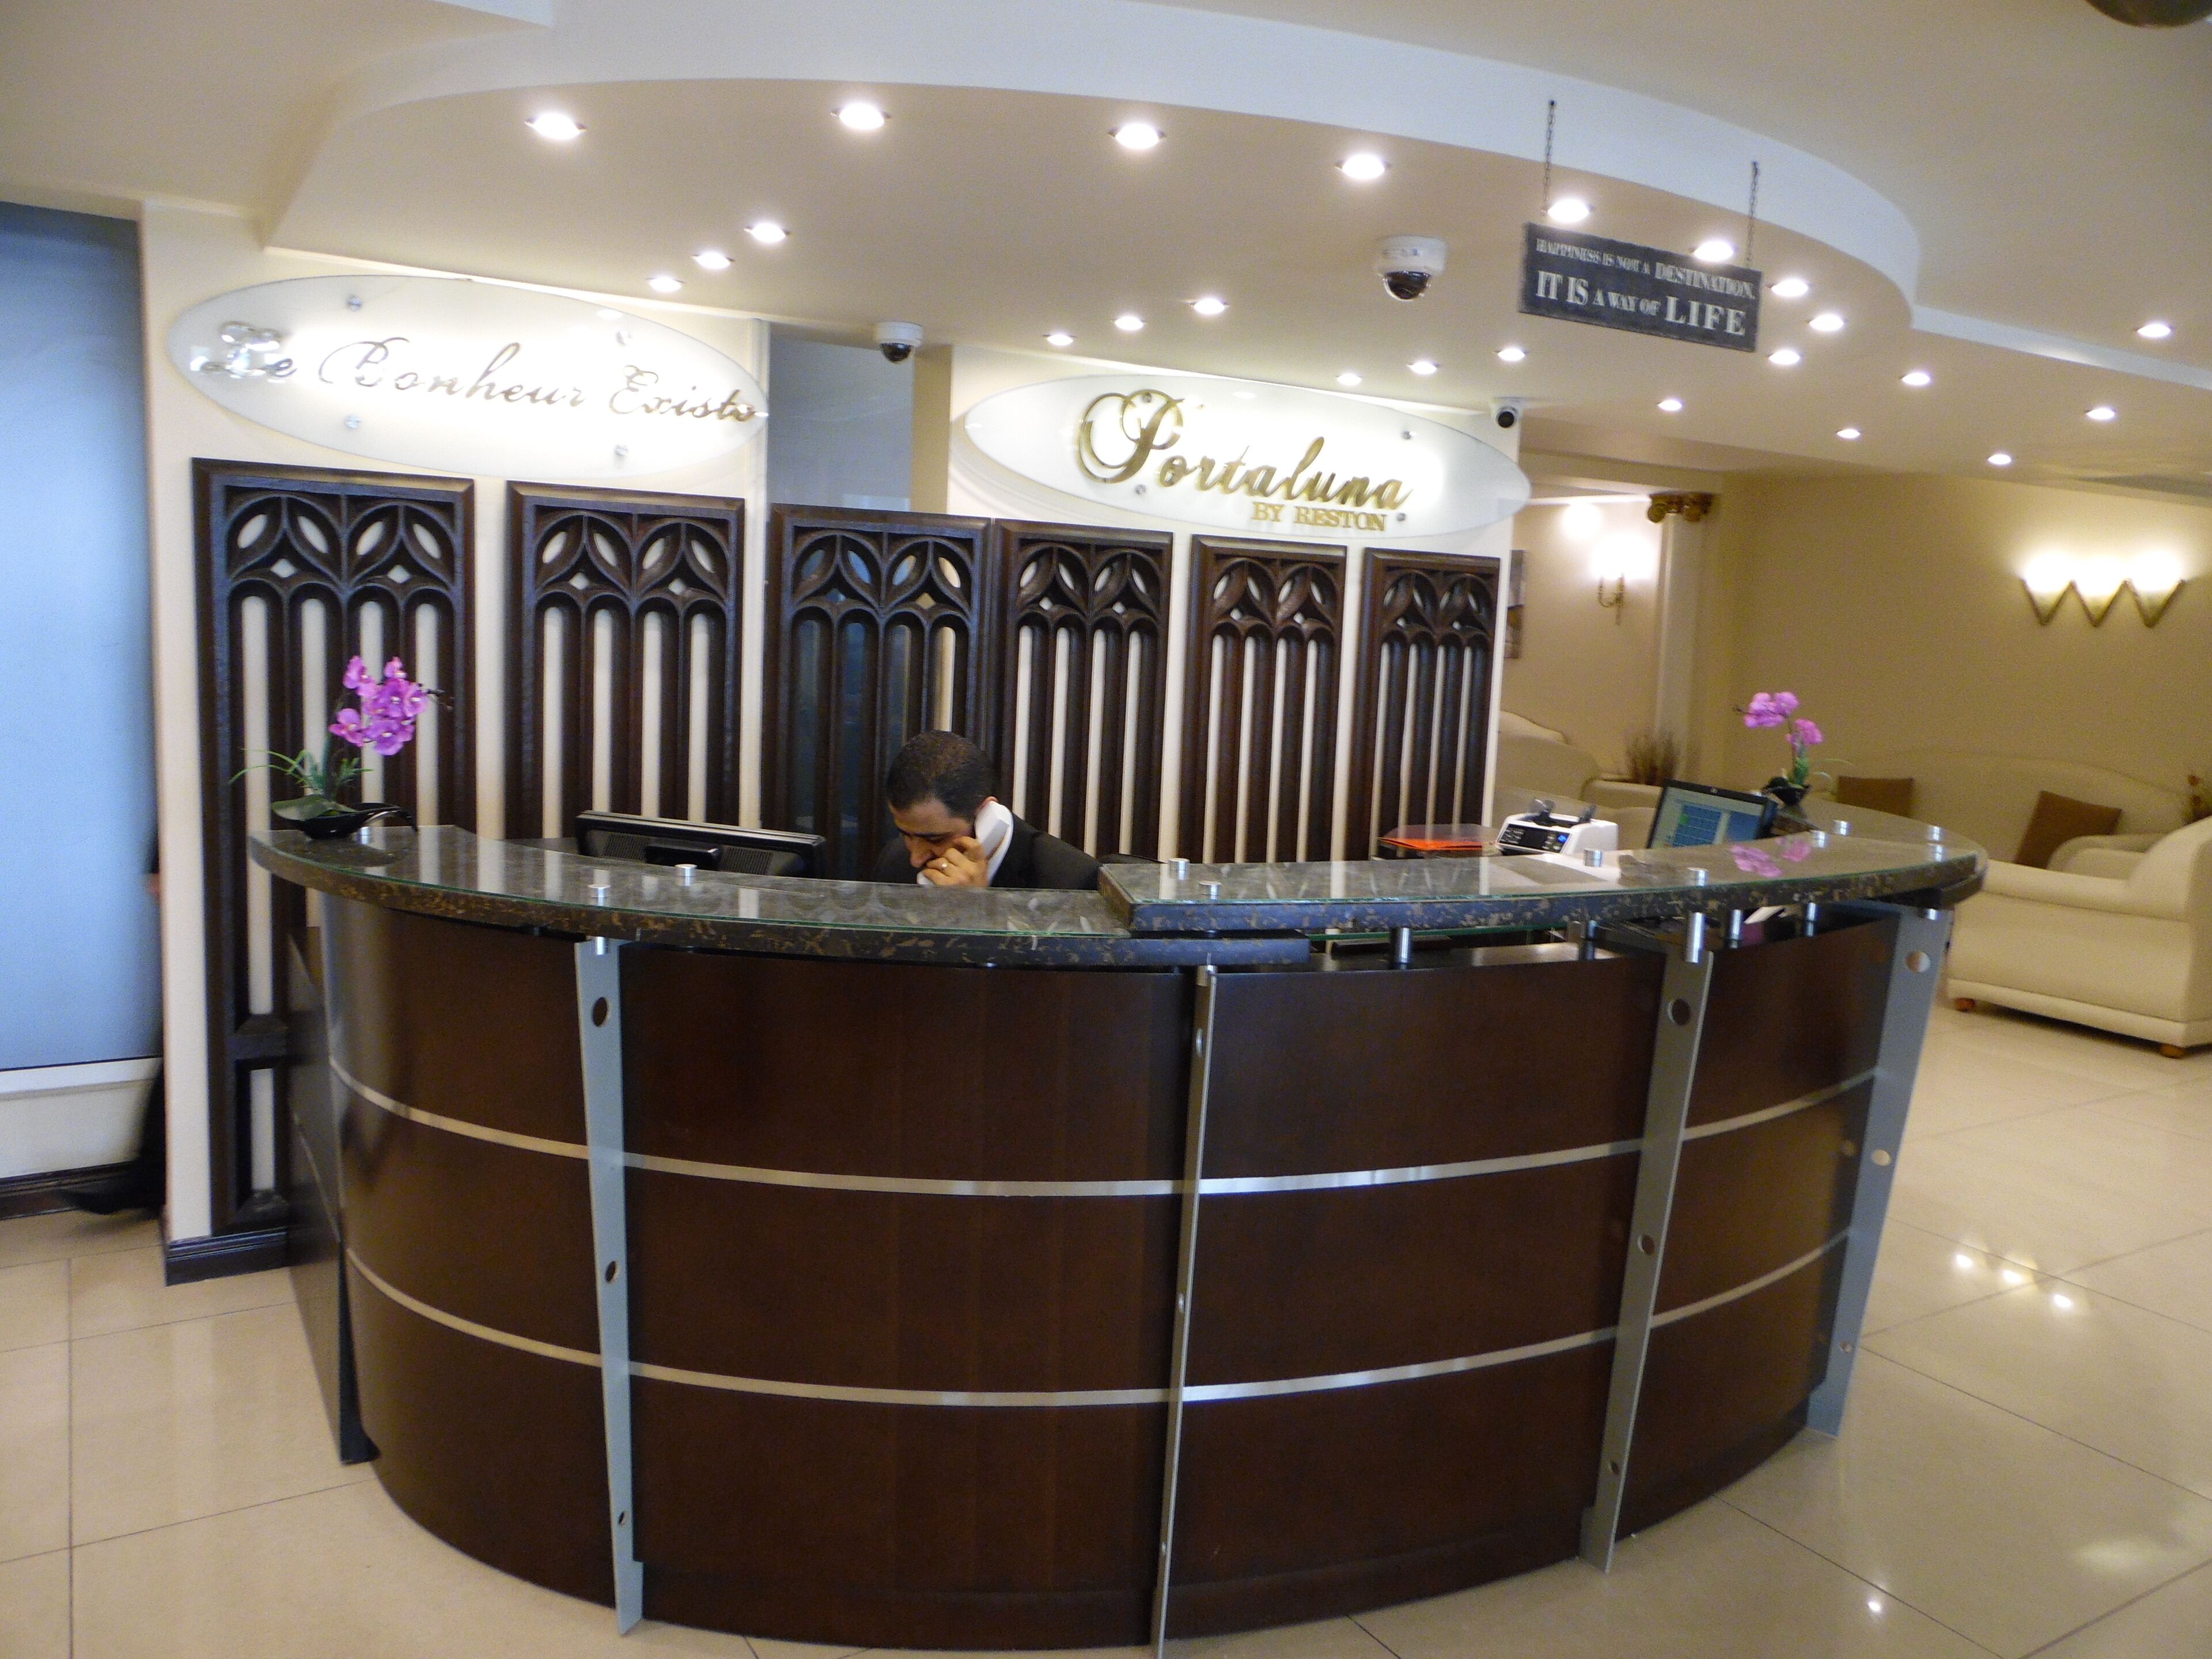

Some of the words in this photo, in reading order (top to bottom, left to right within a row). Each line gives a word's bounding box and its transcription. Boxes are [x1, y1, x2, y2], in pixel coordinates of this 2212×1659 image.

[1536, 237, 1601, 264] HAPPINESS
[1603, 252, 1614, 266] IS
[1616, 256, 1640, 273] NOT
[1641, 262, 1652, 275] A
[1536, 270, 1563, 300] IT
[1566, 276, 1589, 305] IS
[1592, 289, 1605, 306] A
[1607, 291, 1639, 312] WAY
[1640, 298, 1661, 316] OF
[1664, 295, 1747, 336] LIFE
[318, 336, 586, 407] Bonheur
[1075, 388, 1414, 510] Portaluna
[1251, 501, 1286, 522] BY
[1293, 505, 1388, 532] RESTON
